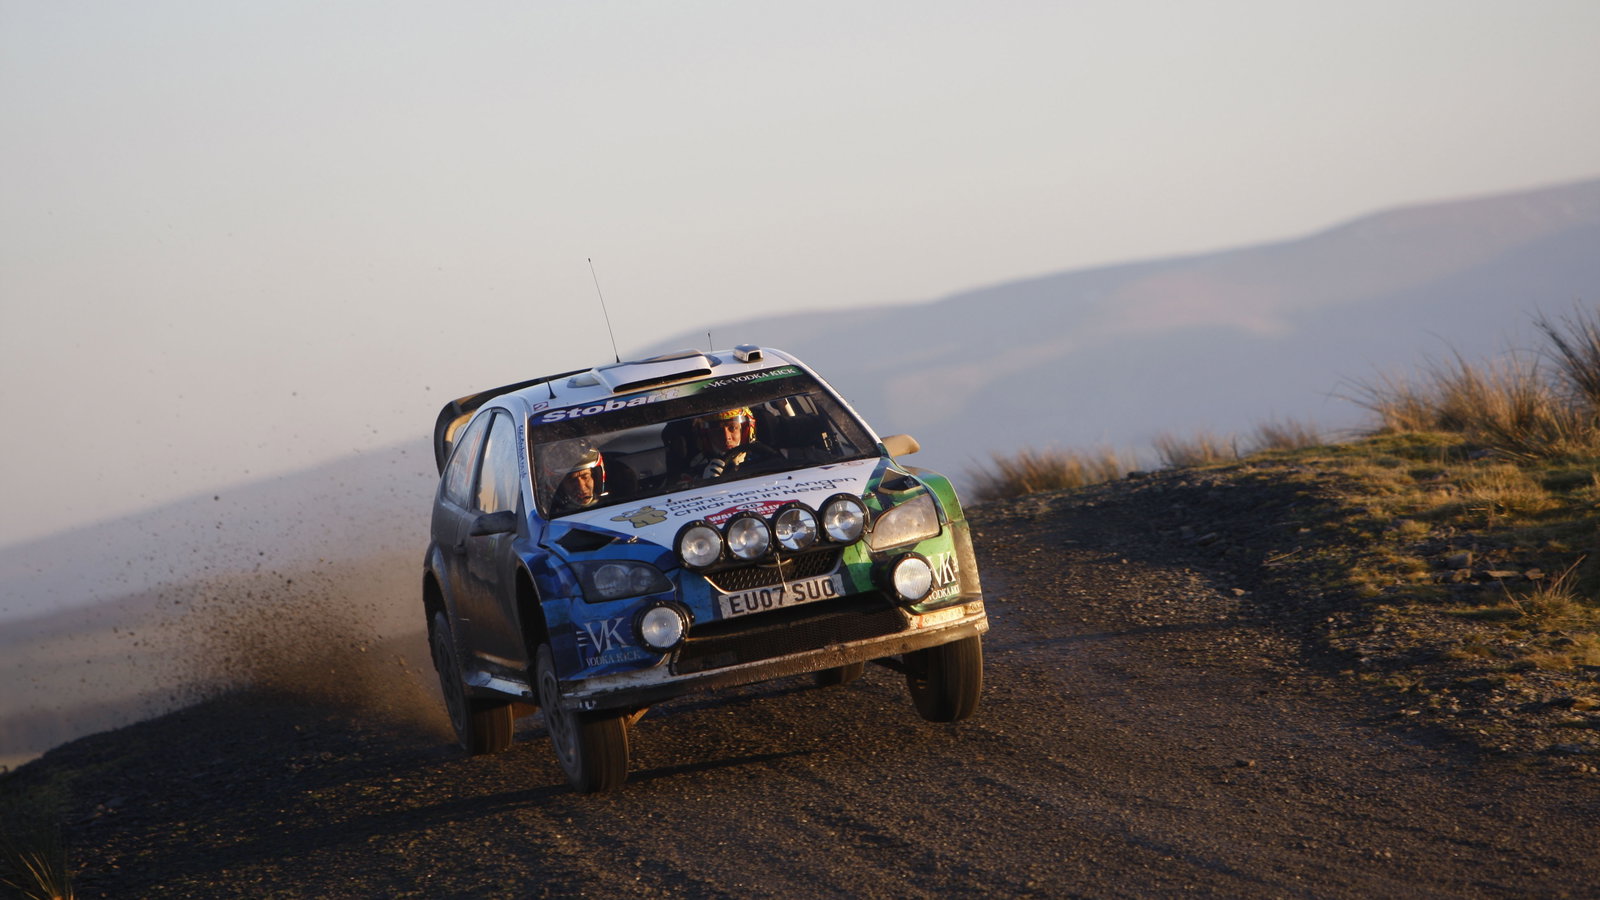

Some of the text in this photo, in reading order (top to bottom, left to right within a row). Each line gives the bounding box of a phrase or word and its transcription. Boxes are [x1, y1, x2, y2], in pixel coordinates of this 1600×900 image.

[732, 372, 768, 384] VODKA
[769, 368, 796, 377] KICK
[542, 388, 679, 423] Stobart
[674, 495, 759, 516] Children
[783, 483, 838, 495] Need
[926, 552, 956, 587] VK
[728, 579, 836, 615] EU07 SUO
[584, 616, 631, 653] VK
